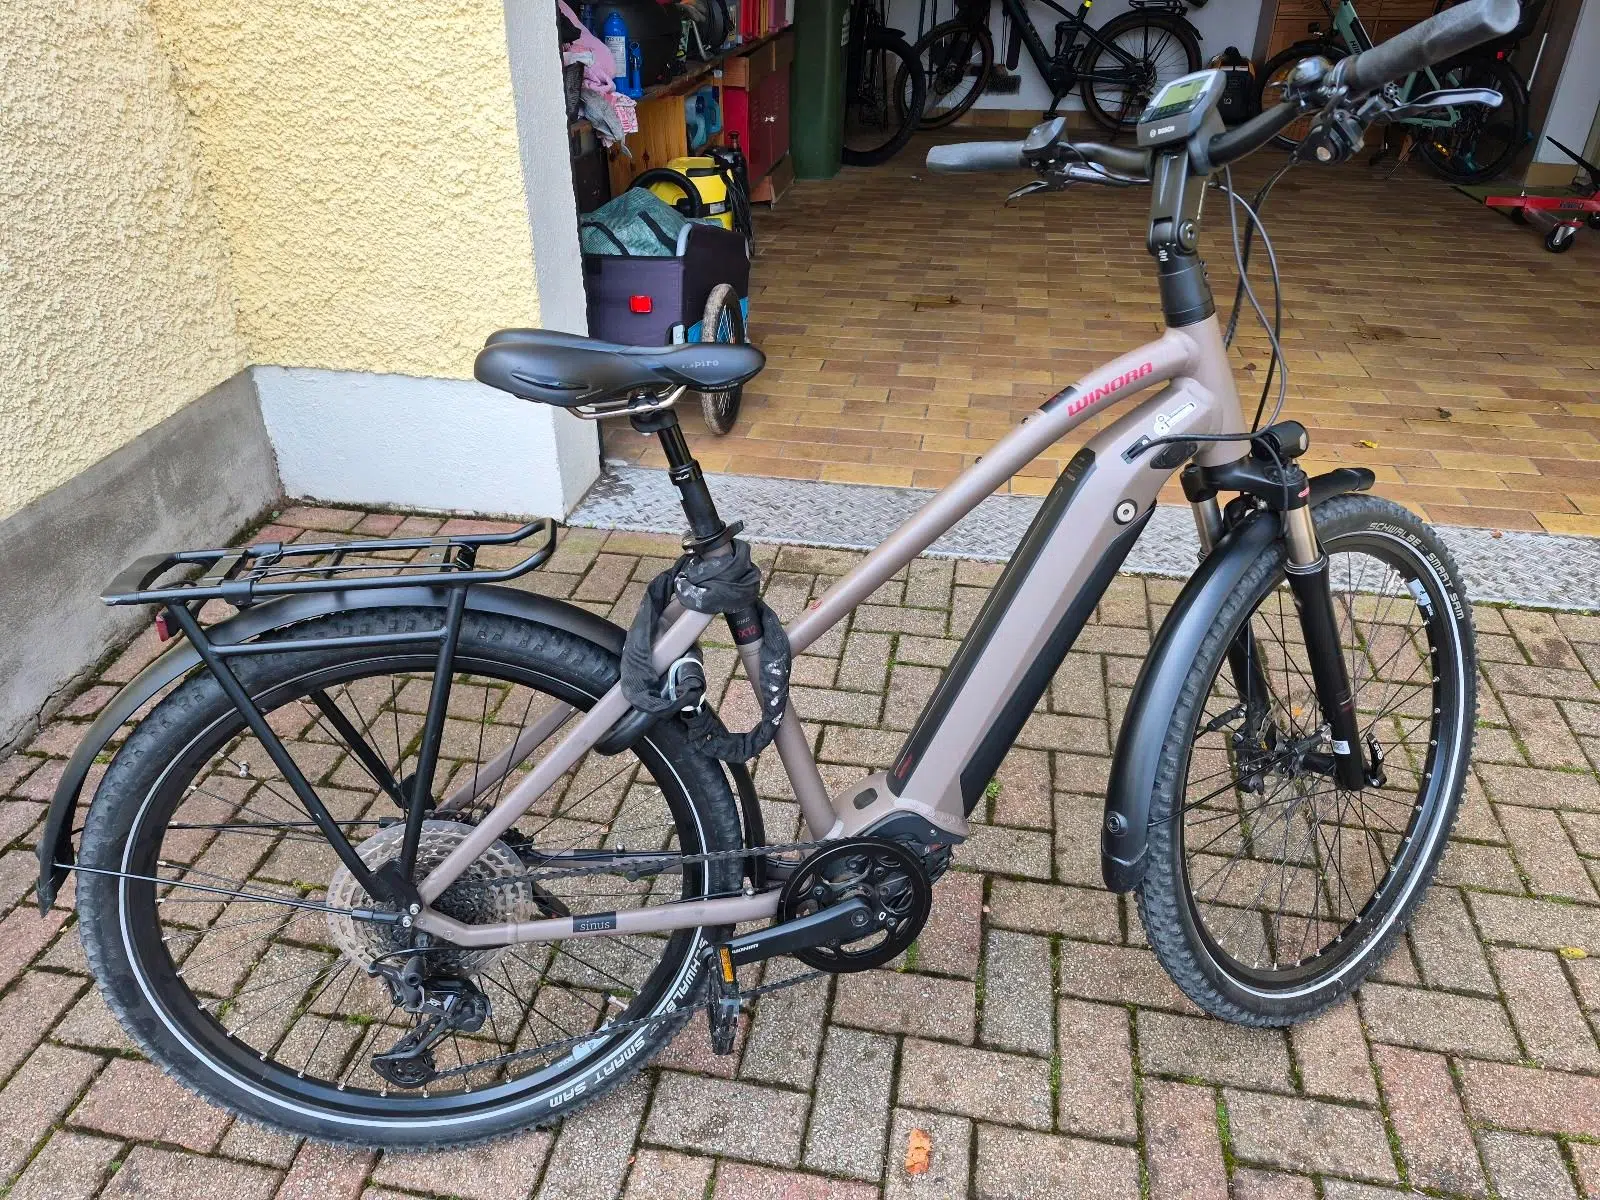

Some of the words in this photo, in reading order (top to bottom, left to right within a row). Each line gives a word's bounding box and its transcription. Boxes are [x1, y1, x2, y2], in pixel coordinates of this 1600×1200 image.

[1067, 362, 1153, 417] WINORA
[1367, 522, 1422, 548] SCHWALBE
[1425, 552, 1454, 588] SMART
[1449, 592, 1465, 620] SAM
[580, 920, 610, 931] sinus
[594, 1035, 647, 1086] SMART
[550, 1081, 587, 1108] SAM
